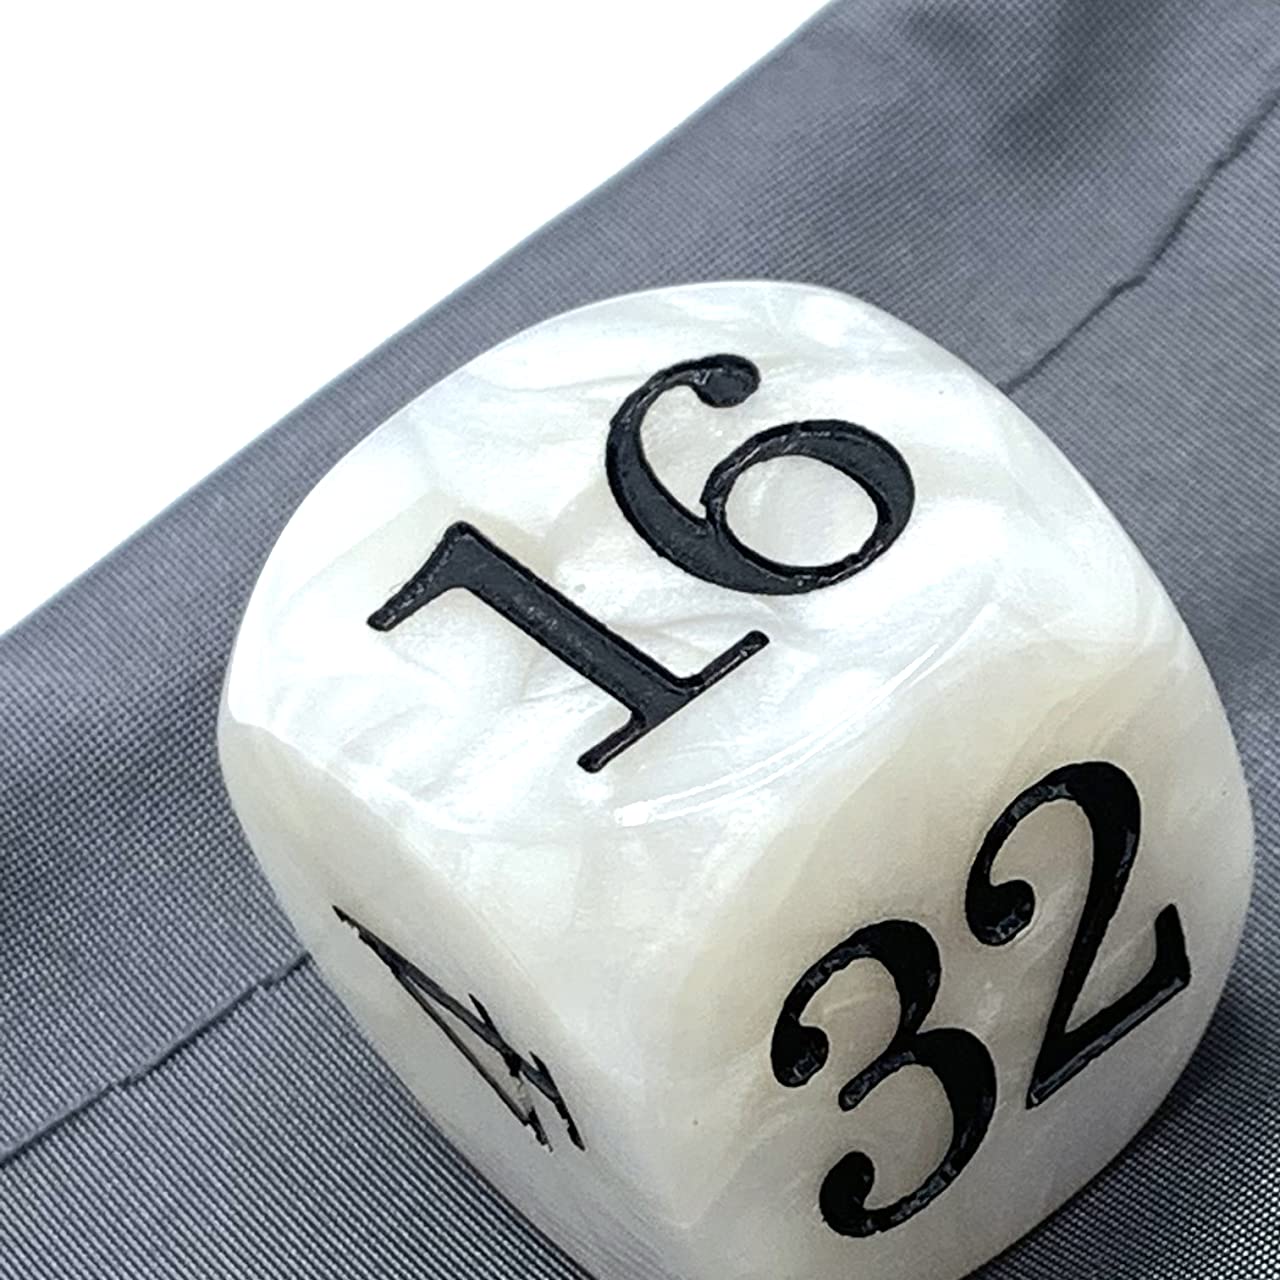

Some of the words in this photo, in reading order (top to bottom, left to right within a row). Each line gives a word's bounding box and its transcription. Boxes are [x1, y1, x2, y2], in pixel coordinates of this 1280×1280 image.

[366, 353, 916, 774] 16
[331, 904, 586, 1153] 4
[770, 760, 1193, 1239] 32
